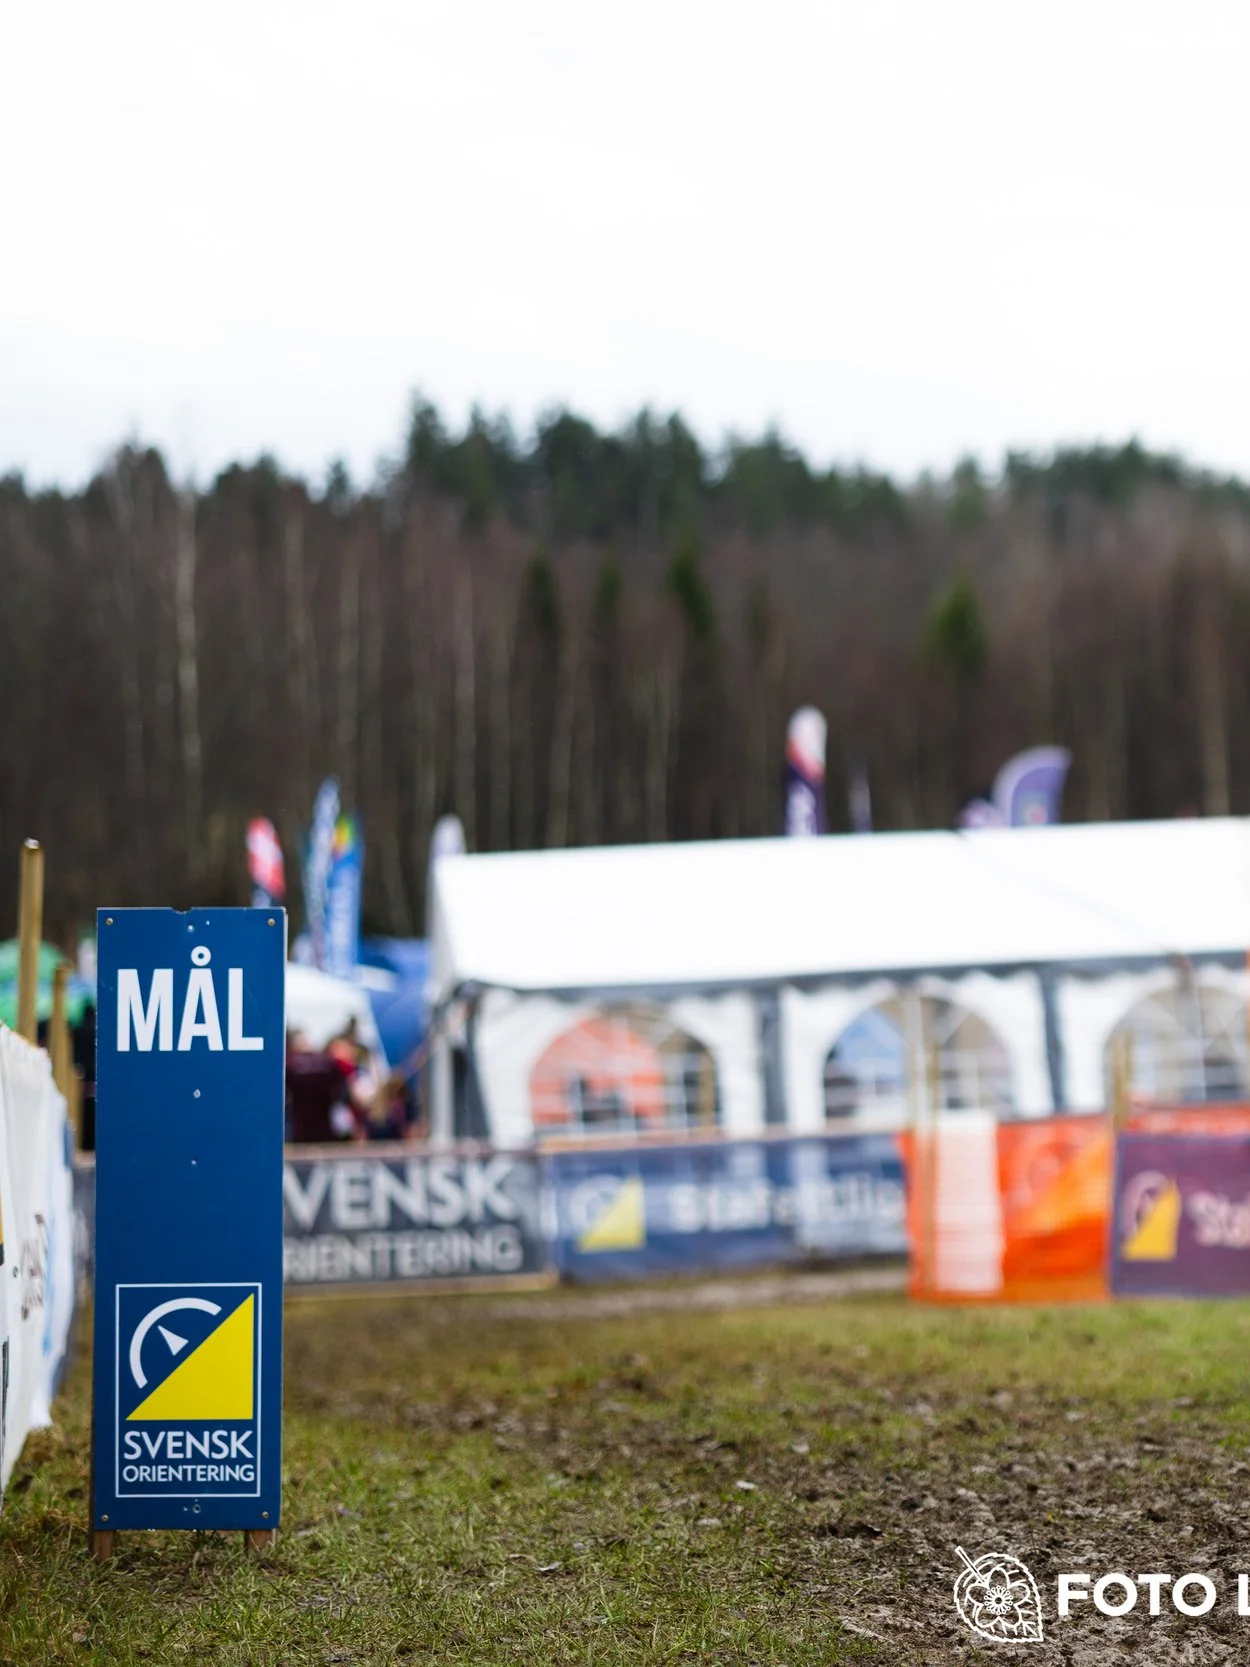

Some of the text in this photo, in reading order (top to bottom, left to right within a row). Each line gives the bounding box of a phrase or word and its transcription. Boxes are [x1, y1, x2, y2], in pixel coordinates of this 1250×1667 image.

[117, 945, 264, 1052] MÅL
[284, 1157, 517, 1232] VENSK
[284, 1226, 524, 1285] RIENTERING
[122, 1464, 255, 1482] ORIENTERING
[123, 1430, 255, 1460] SVENSK
